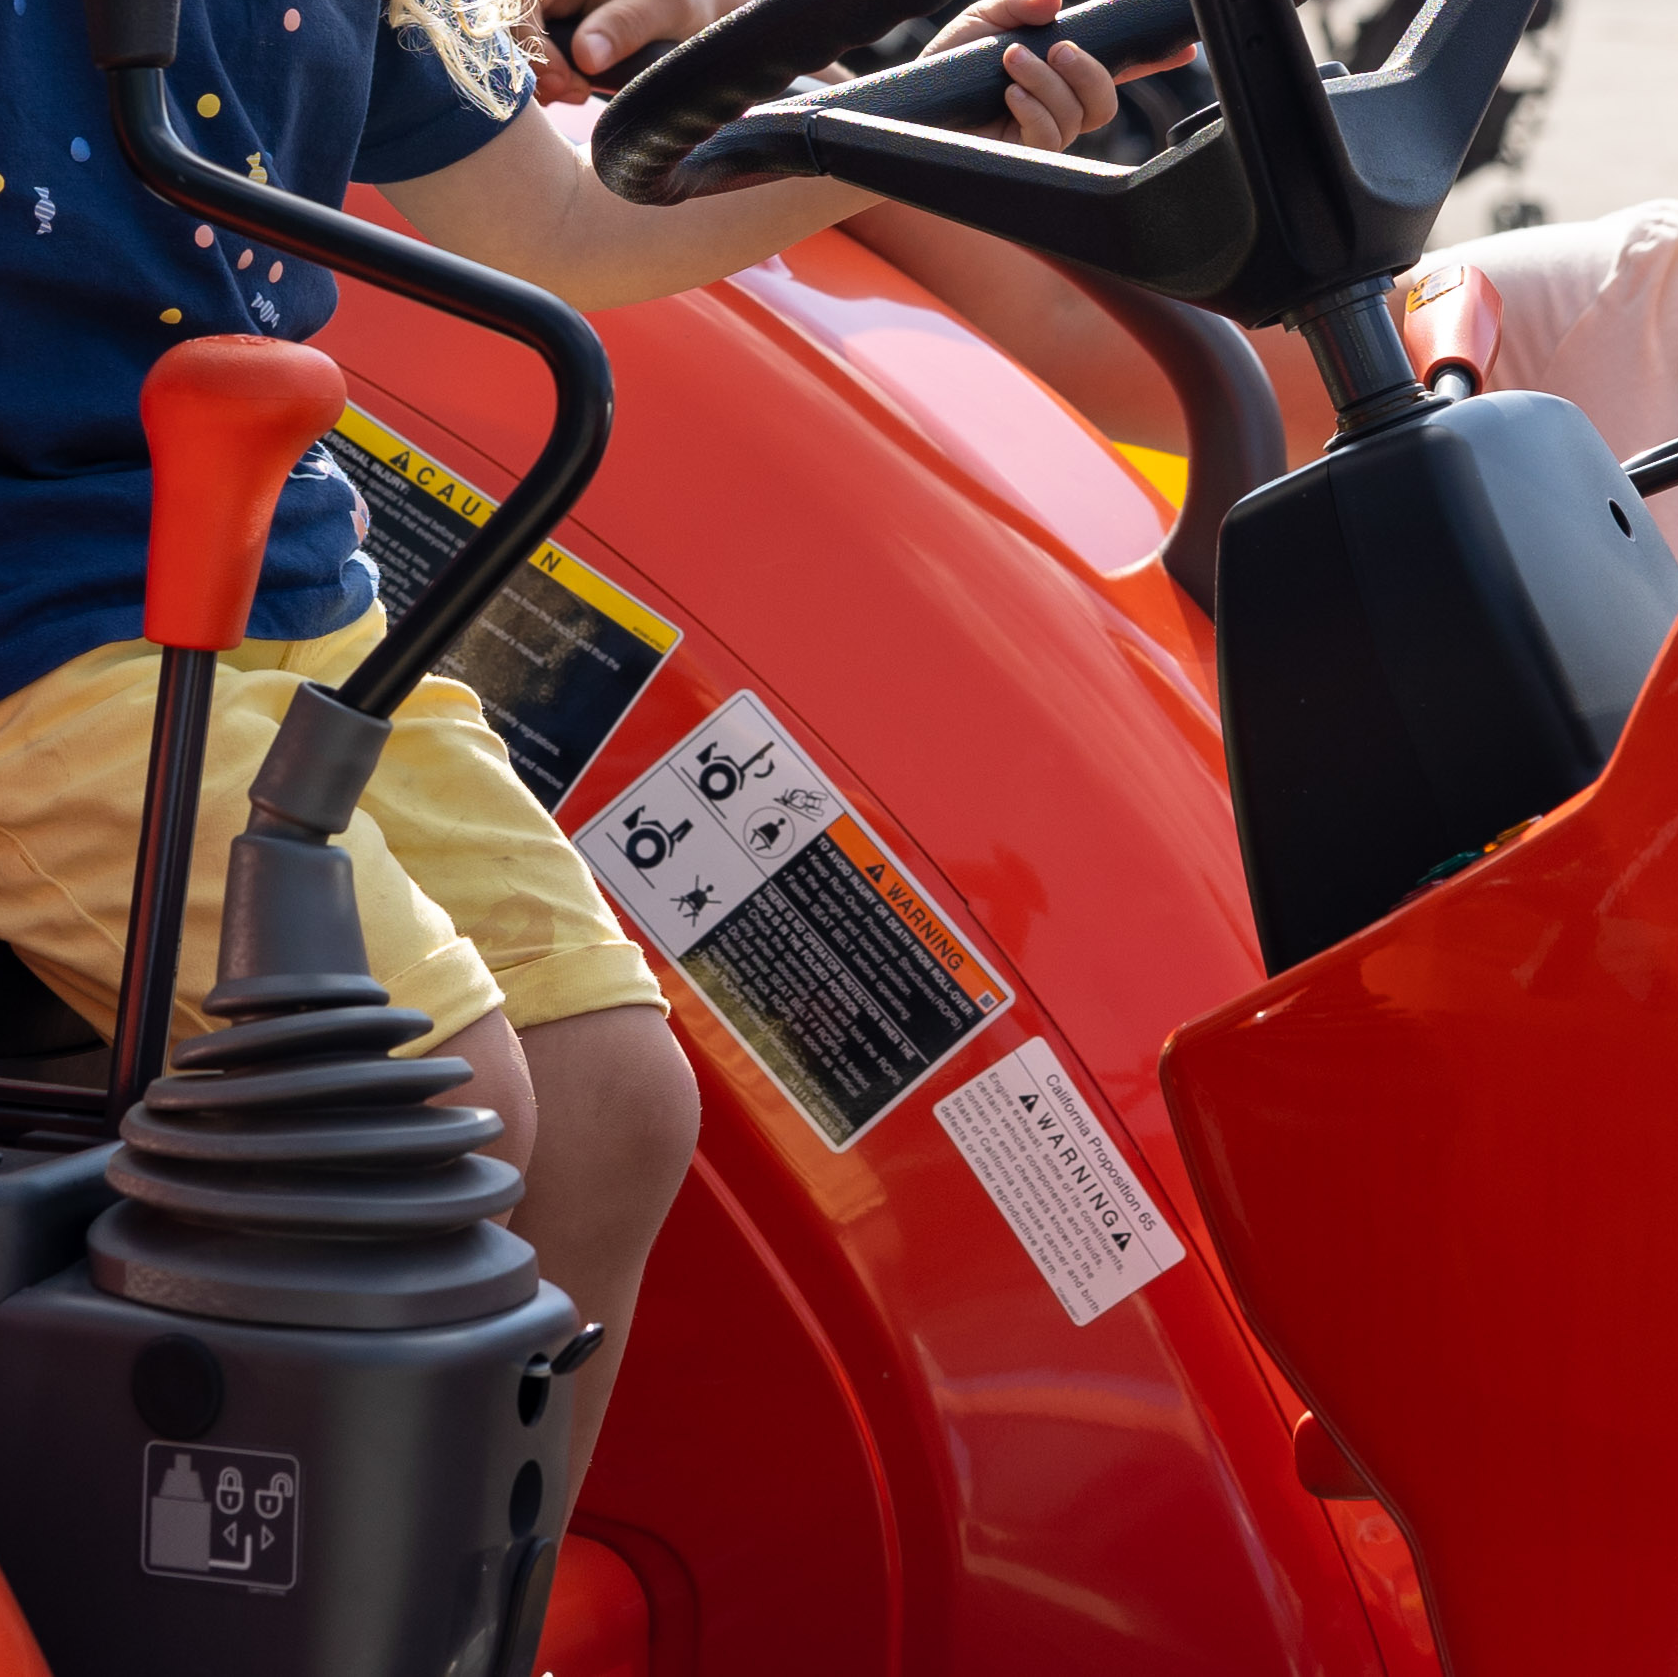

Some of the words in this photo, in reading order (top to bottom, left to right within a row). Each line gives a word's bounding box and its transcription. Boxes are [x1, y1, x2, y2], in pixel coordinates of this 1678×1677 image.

[322, 428, 372, 468] ERSONAL
[750, 892, 775, 918] ROPS
[768, 913, 783, 928] IS
[776, 922, 791, 937] IN
[784, 931, 805, 953] THE
[798, 947, 831, 983] FOLDED
[760, 883, 788, 913] THERE
[781, 908, 796, 923] IS
[789, 917, 807, 935] NO
[800, 930, 842, 976] OPERATOR
[835, 970, 882, 1022] PROTECTION
[875, 1017, 902, 1045] WHEN
[896, 1040, 916, 1061] THE
[783, 873, 814, 906] Fasten
[808, 901, 835, 931] SEAT
[829, 926, 857, 955] BELT
[850, 950, 879, 982] before
[795, 863, 809, 877] in
[803, 872, 821, 892] the
[814, 887, 846, 922] upright
[841, 916, 861, 937] and
[855, 933, 885, 965] locked
[805, 852, 833, 881] Keep
[826, 875, 866, 919] Roll-Over
[861, 914, 902, 959] Protective
[815, 836, 832, 853] TO
[825, 848, 854, 878] AVOID
[847, 873, 879, 907] INJURY
[872, 901, 890, 920] OR
[884, 915, 914, 947] DEATH
[908, 942, 935, 971] FROM
[928, 966, 977, 1020] ROLL-OVER:
[883, 881, 967, 972] WARNING
[726, 923, 744, 942] Do
[737, 936, 756, 956] not
[749, 950, 774, 976] wear
[767, 971, 795, 1001] SEAT
[787, 995, 814, 1024] BELT
[813, 1025, 843, 1057] ROPS
[836, 1051, 850, 1066] is
[746, 906, 775, 937] Check
[769, 932, 788, 953] the
[780, 947, 821, 992] operating
[814, 986, 838, 1011] area
[832, 1006, 853, 1028] and
[846, 1023, 867, 1045] fold
[861, 1040, 880, 1060] the
[874, 1055, 904, 1087] ROPS
[938, 1103, 970, 1143] defects
[964, 1142, 977, 1156] or
[972, 1153, 998, 1184] other
[990, 1182, 1041, 1249] reproductive
[950, 1095, 975, 1125] State
[969, 1122, 984, 1138] of
[977, 1134, 1018, 1188] California
[1011, 1185, 1025, 1200] to
[1019, 1198, 1046, 1232] cause
[1040, 1230, 1070, 1268] cancer
[1065, 1266, 1085, 1290] and
[1078, 1287, 1102, 1315] birth
[962, 1086, 993, 1127] contain
[987, 1125, 1001, 1140] or
[996, 1137, 1019, 1164] emit
[1012, 1161, 1053, 1215] chemicals
[1047, 1212, 1076, 1249] known
[1070, 1247, 1084, 1262] to
[1078, 1260, 1097, 1281] the
[973, 1078, 1004, 1117] certain
[998, 1114, 1029, 1154] vehicle
[1022, 1151, 1070, 1216] components
[1064, 1213, 1085, 1237] and
[985, 1070, 1017, 1109] Engine
[1040, 1151, 1065, 1182] some
[1059, 1179, 1074, 1195] of
[1068, 1192, 1084, 1210] its
[1077, 1207, 1128, 1275] constituents,
[1043, 1070, 1095, 1138] California
[1083, 1134, 1145, 1215] Proposition
[1135, 1209, 1158, 1234] 65
